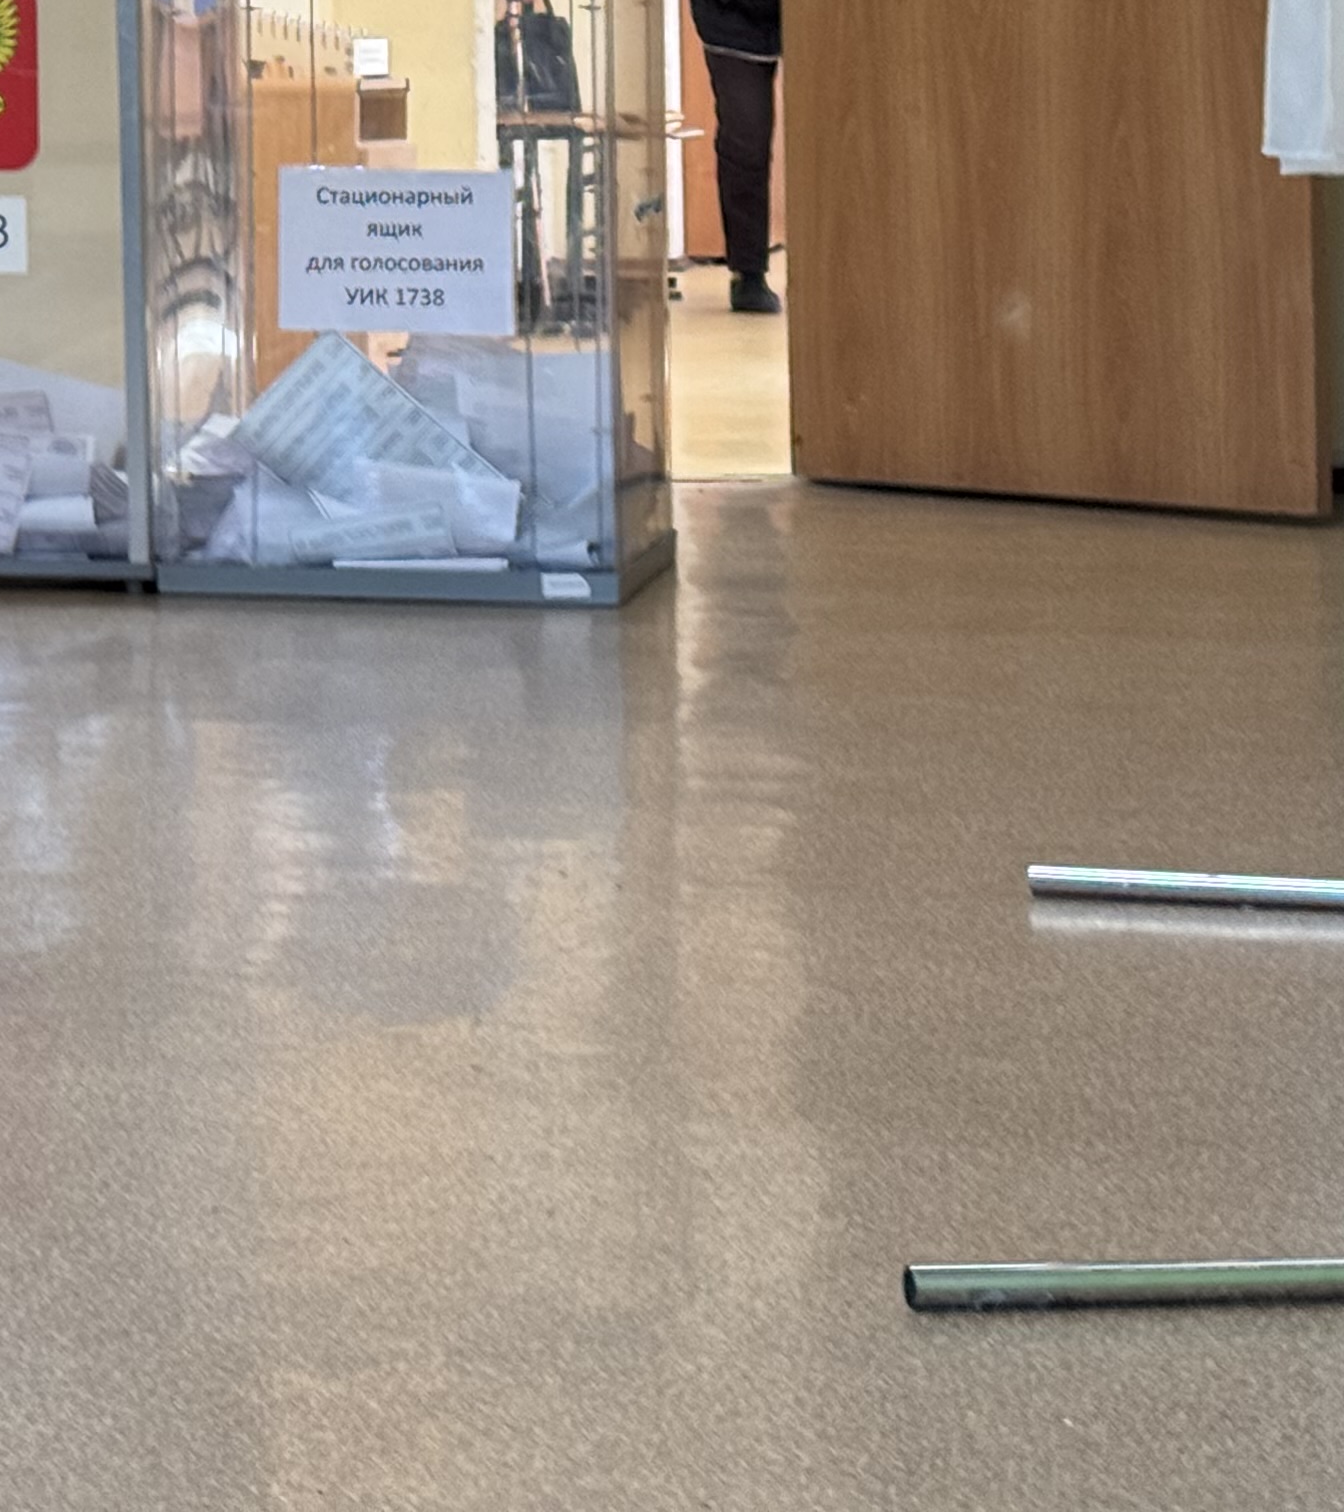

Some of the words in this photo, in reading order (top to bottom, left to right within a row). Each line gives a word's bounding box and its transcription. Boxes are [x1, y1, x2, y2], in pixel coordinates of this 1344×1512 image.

[316, 186, 474, 208] Стационарный
[366, 222, 423, 239] ящик
[305, 256, 344, 273] для
[351, 256, 485, 272] голосования
[345, 287, 389, 305] УИК
[395, 287, 445, 306] 1738
